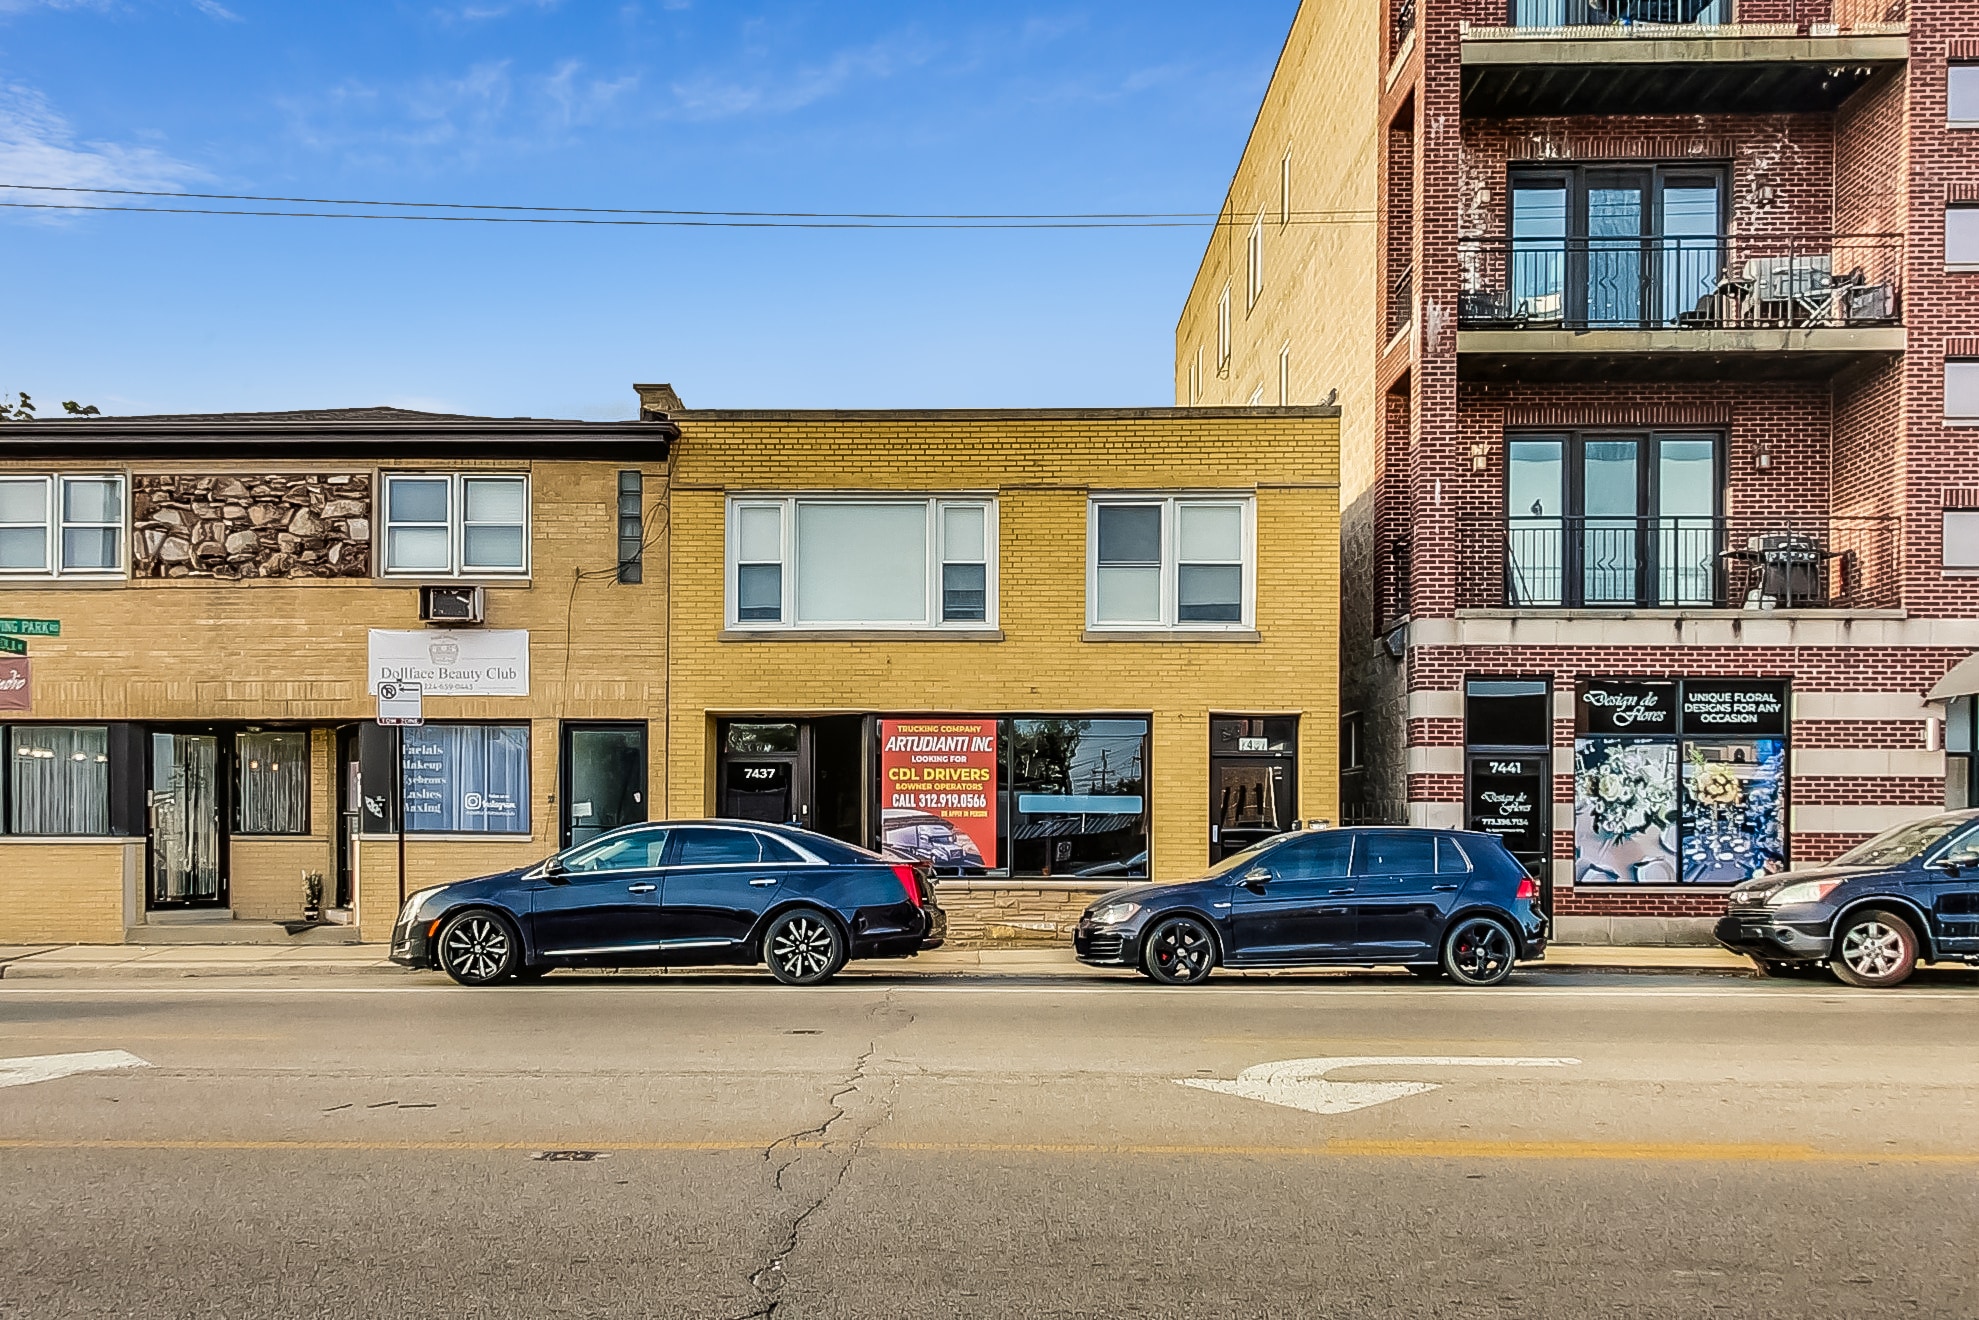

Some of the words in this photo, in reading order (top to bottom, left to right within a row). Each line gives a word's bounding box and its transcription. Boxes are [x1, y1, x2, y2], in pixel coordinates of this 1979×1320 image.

[22, 621, 49, 634] PARK
[381, 667, 435, 680] Dollface
[439, 667, 481, 682] Beauty
[486, 667, 517, 680] Club
[1583, 690, 1637, 711] Design
[1640, 691, 1658, 707] de
[1688, 693, 1732, 702] UNIQUE
[1734, 693, 1777, 702] FLORAL
[1684, 703, 1732, 713] DESIGNS
[1734, 703, 1756, 713] FOR
[1758, 703, 1781, 713] ANY
[1612, 705, 1667, 727] Flores
[1700, 713, 1758, 723] OCCASION
[897, 725, 939, 733] TRUCKING
[940, 725, 982, 733] COMPANY
[402, 744, 444, 755] Facials
[885, 736, 969, 752] ARTUDIANTI
[971, 736, 994, 752] INC
[911, 755, 949, 763] LOOKING
[950, 755, 967, 763] FOR
[402, 760, 443, 771] Makeup
[1489, 762, 1521, 774] 7441
[744, 768, 776, 779] 7437
[888, 768, 920, 781] CDL
[923, 768, 990, 781] DRIVERS
[934, 783, 983, 791] OPERATORS
[403, 788, 442, 799] Lashes
[1481, 791, 1515, 805] Design
[892, 793, 917, 808] CALL
[918, 793, 987, 808] 312.919.0566
